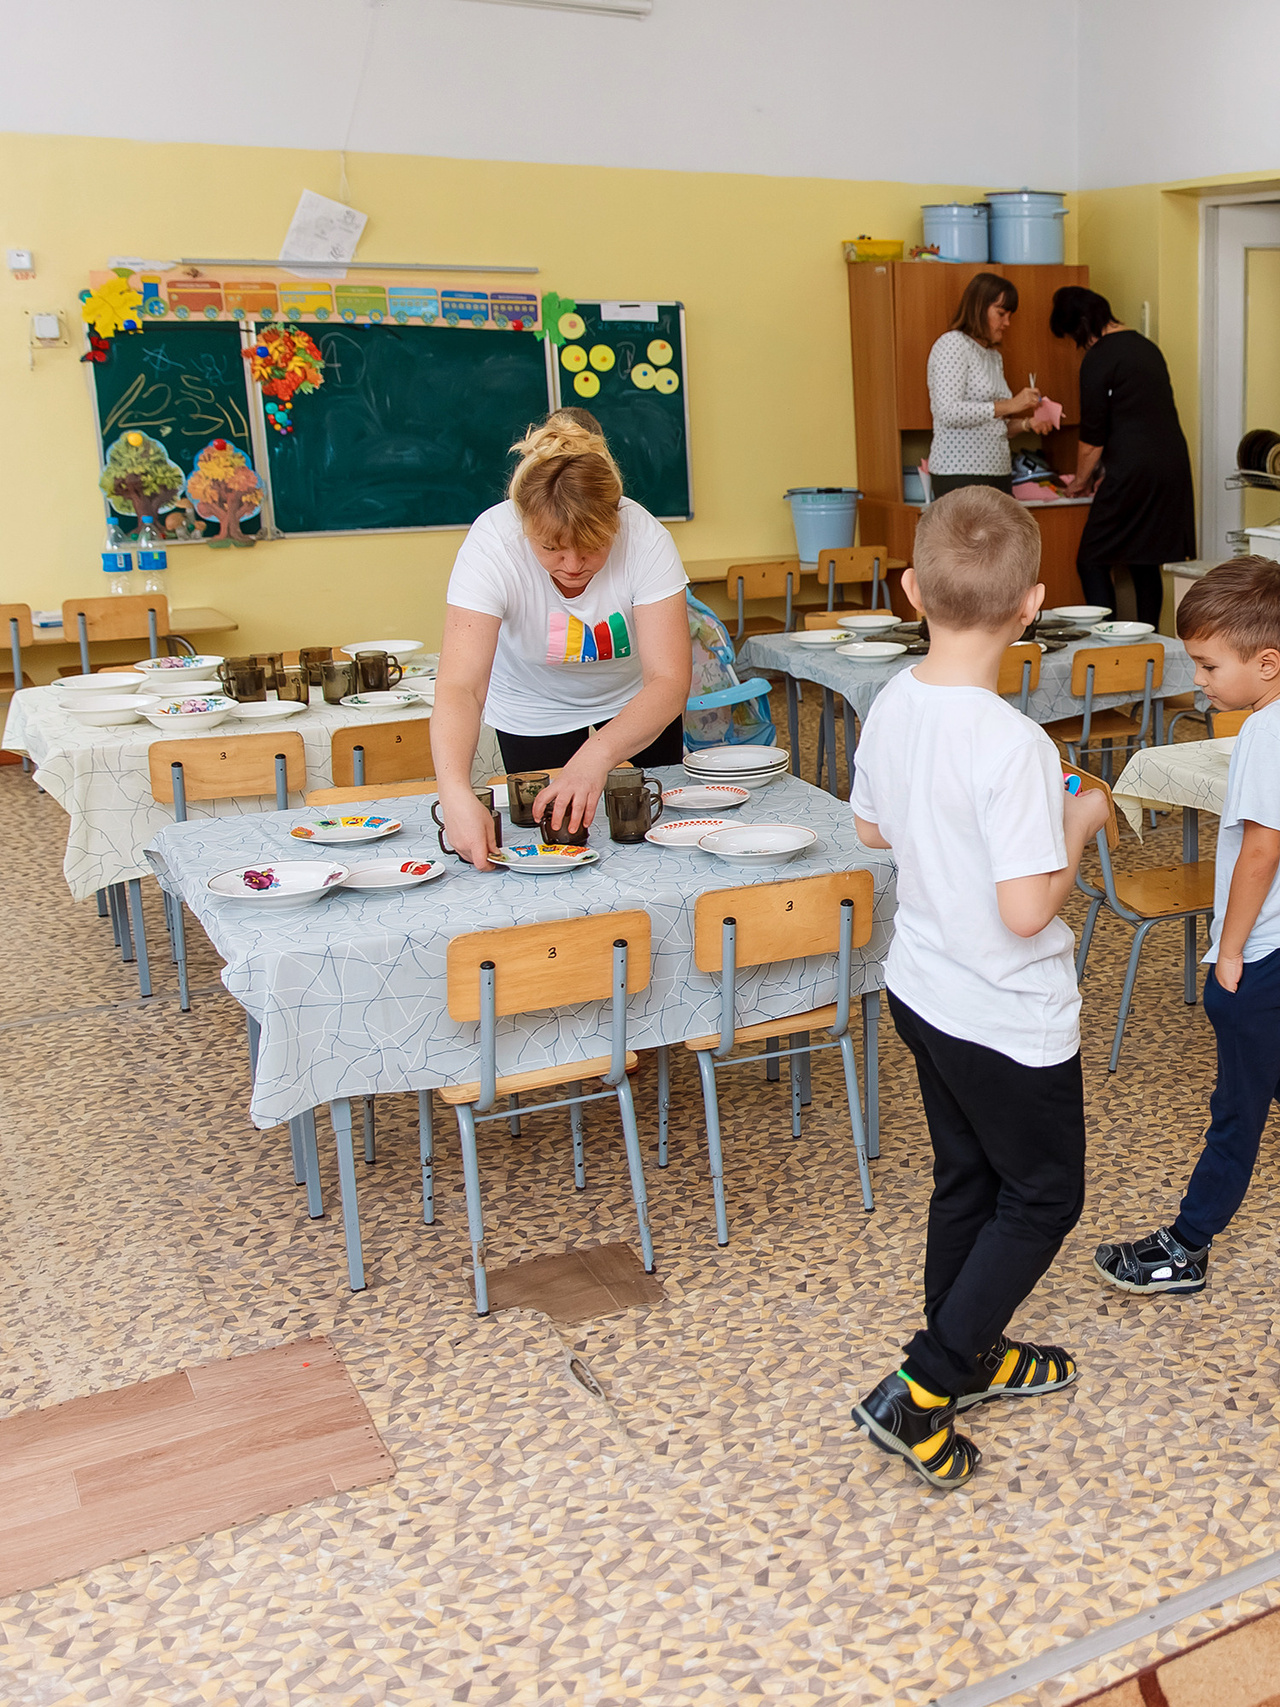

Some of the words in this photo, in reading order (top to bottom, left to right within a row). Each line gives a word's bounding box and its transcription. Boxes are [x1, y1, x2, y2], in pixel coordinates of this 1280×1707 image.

[395, 734, 403, 744] 3
[219, 751, 227, 761] 3
[785, 900, 794, 912] 3
[547, 946, 557, 959] 3
